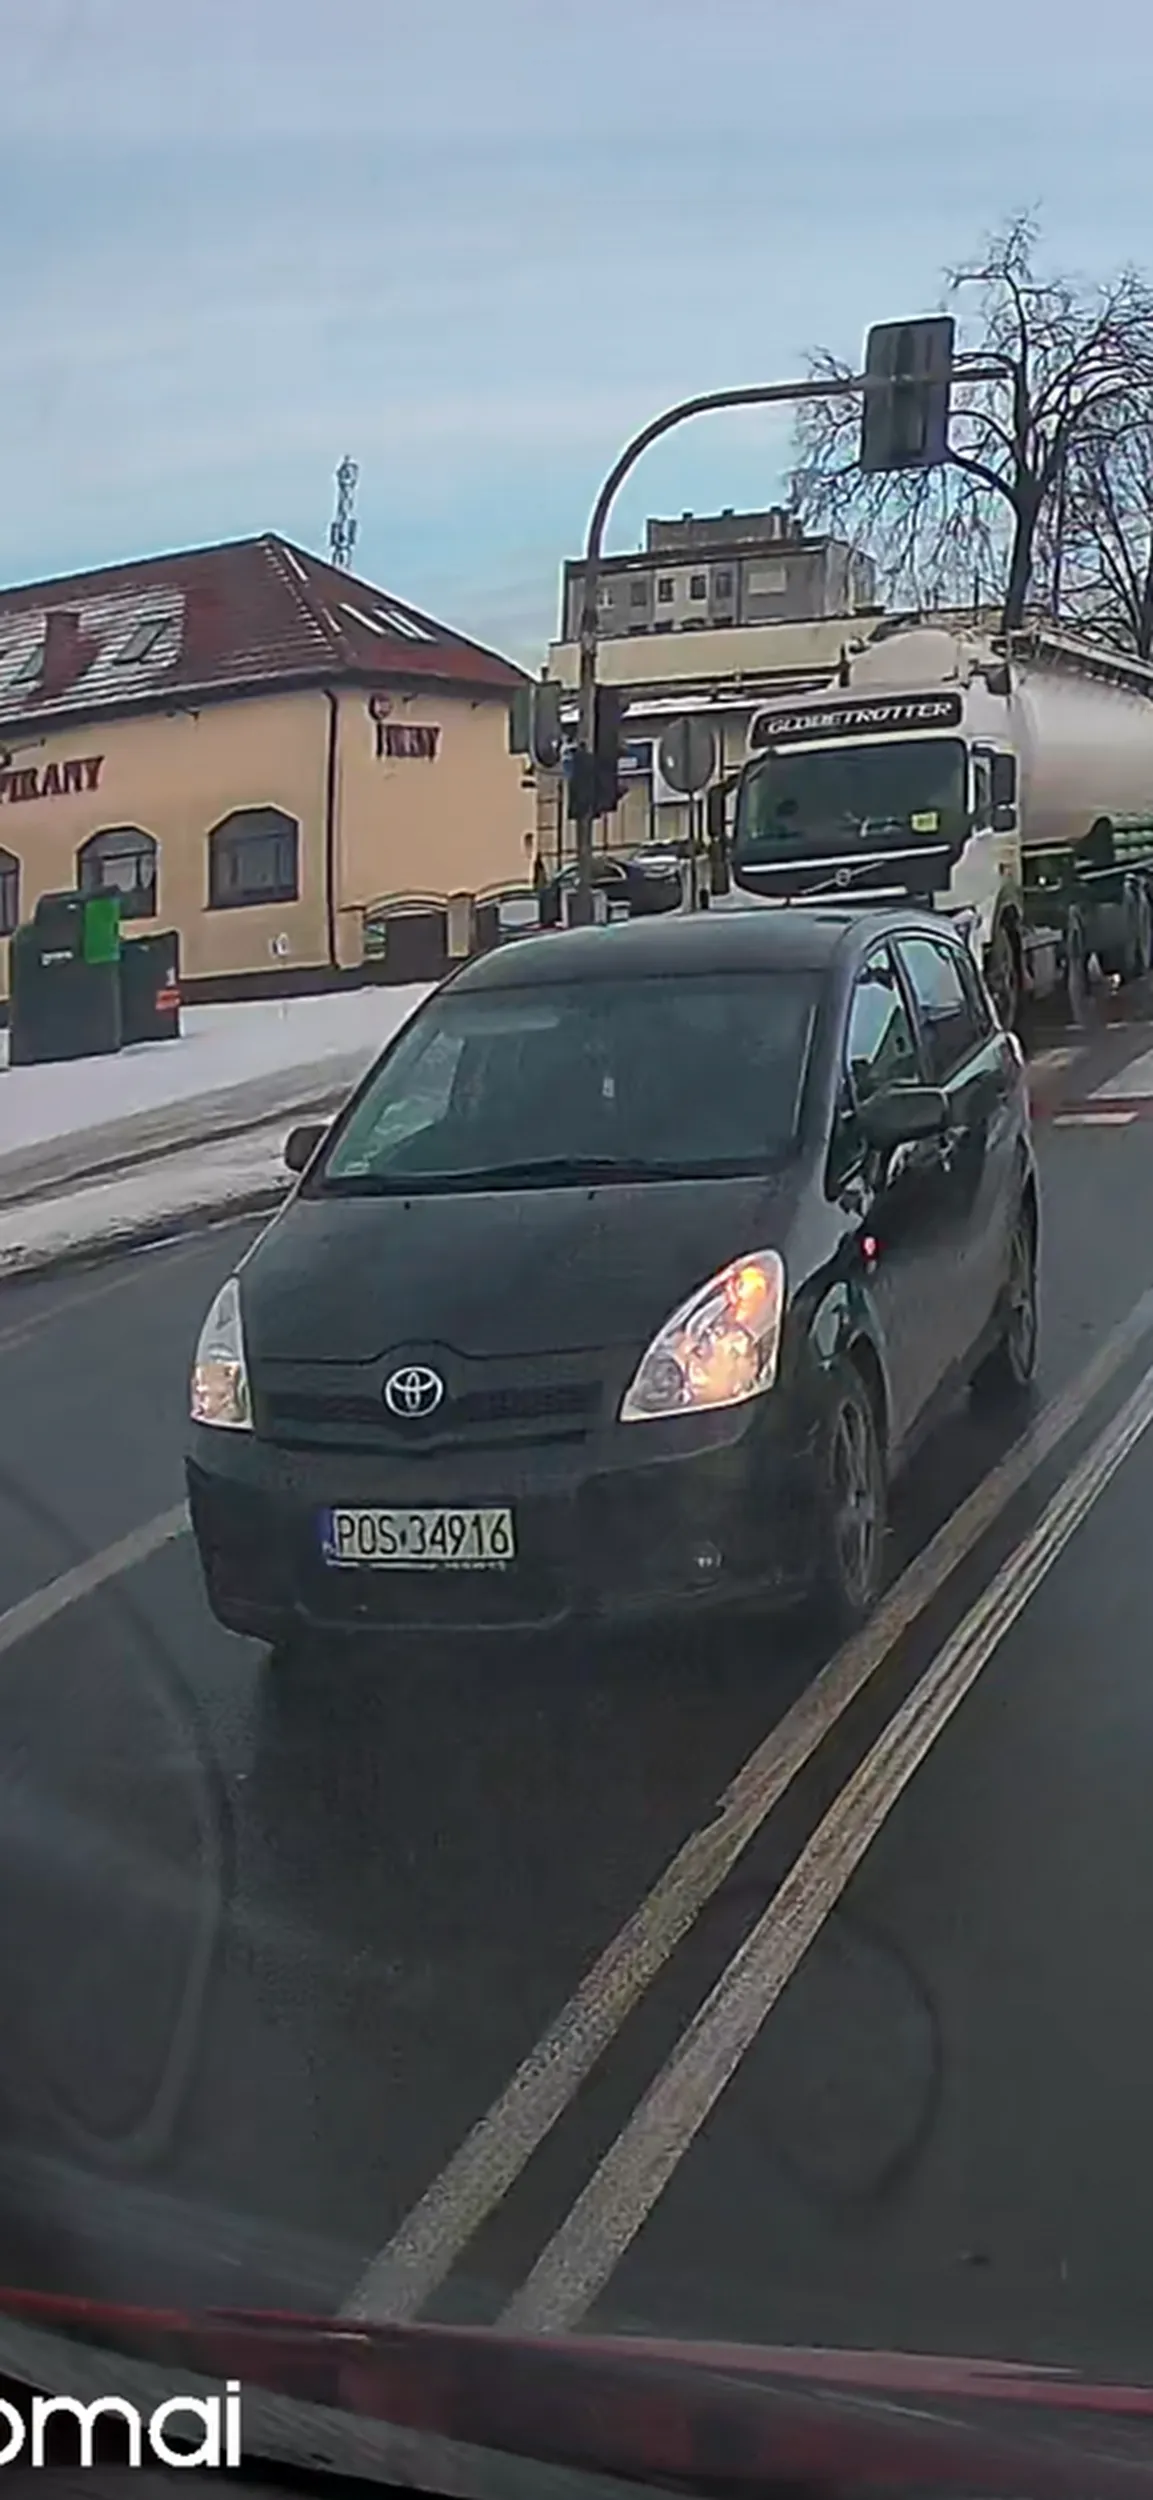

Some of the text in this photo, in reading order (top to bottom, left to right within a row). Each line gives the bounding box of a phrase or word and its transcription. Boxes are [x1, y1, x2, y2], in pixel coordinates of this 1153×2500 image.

[767, 702, 953, 735] GLOBETROTTER
[337, 1513, 510, 1555] POS 34916
